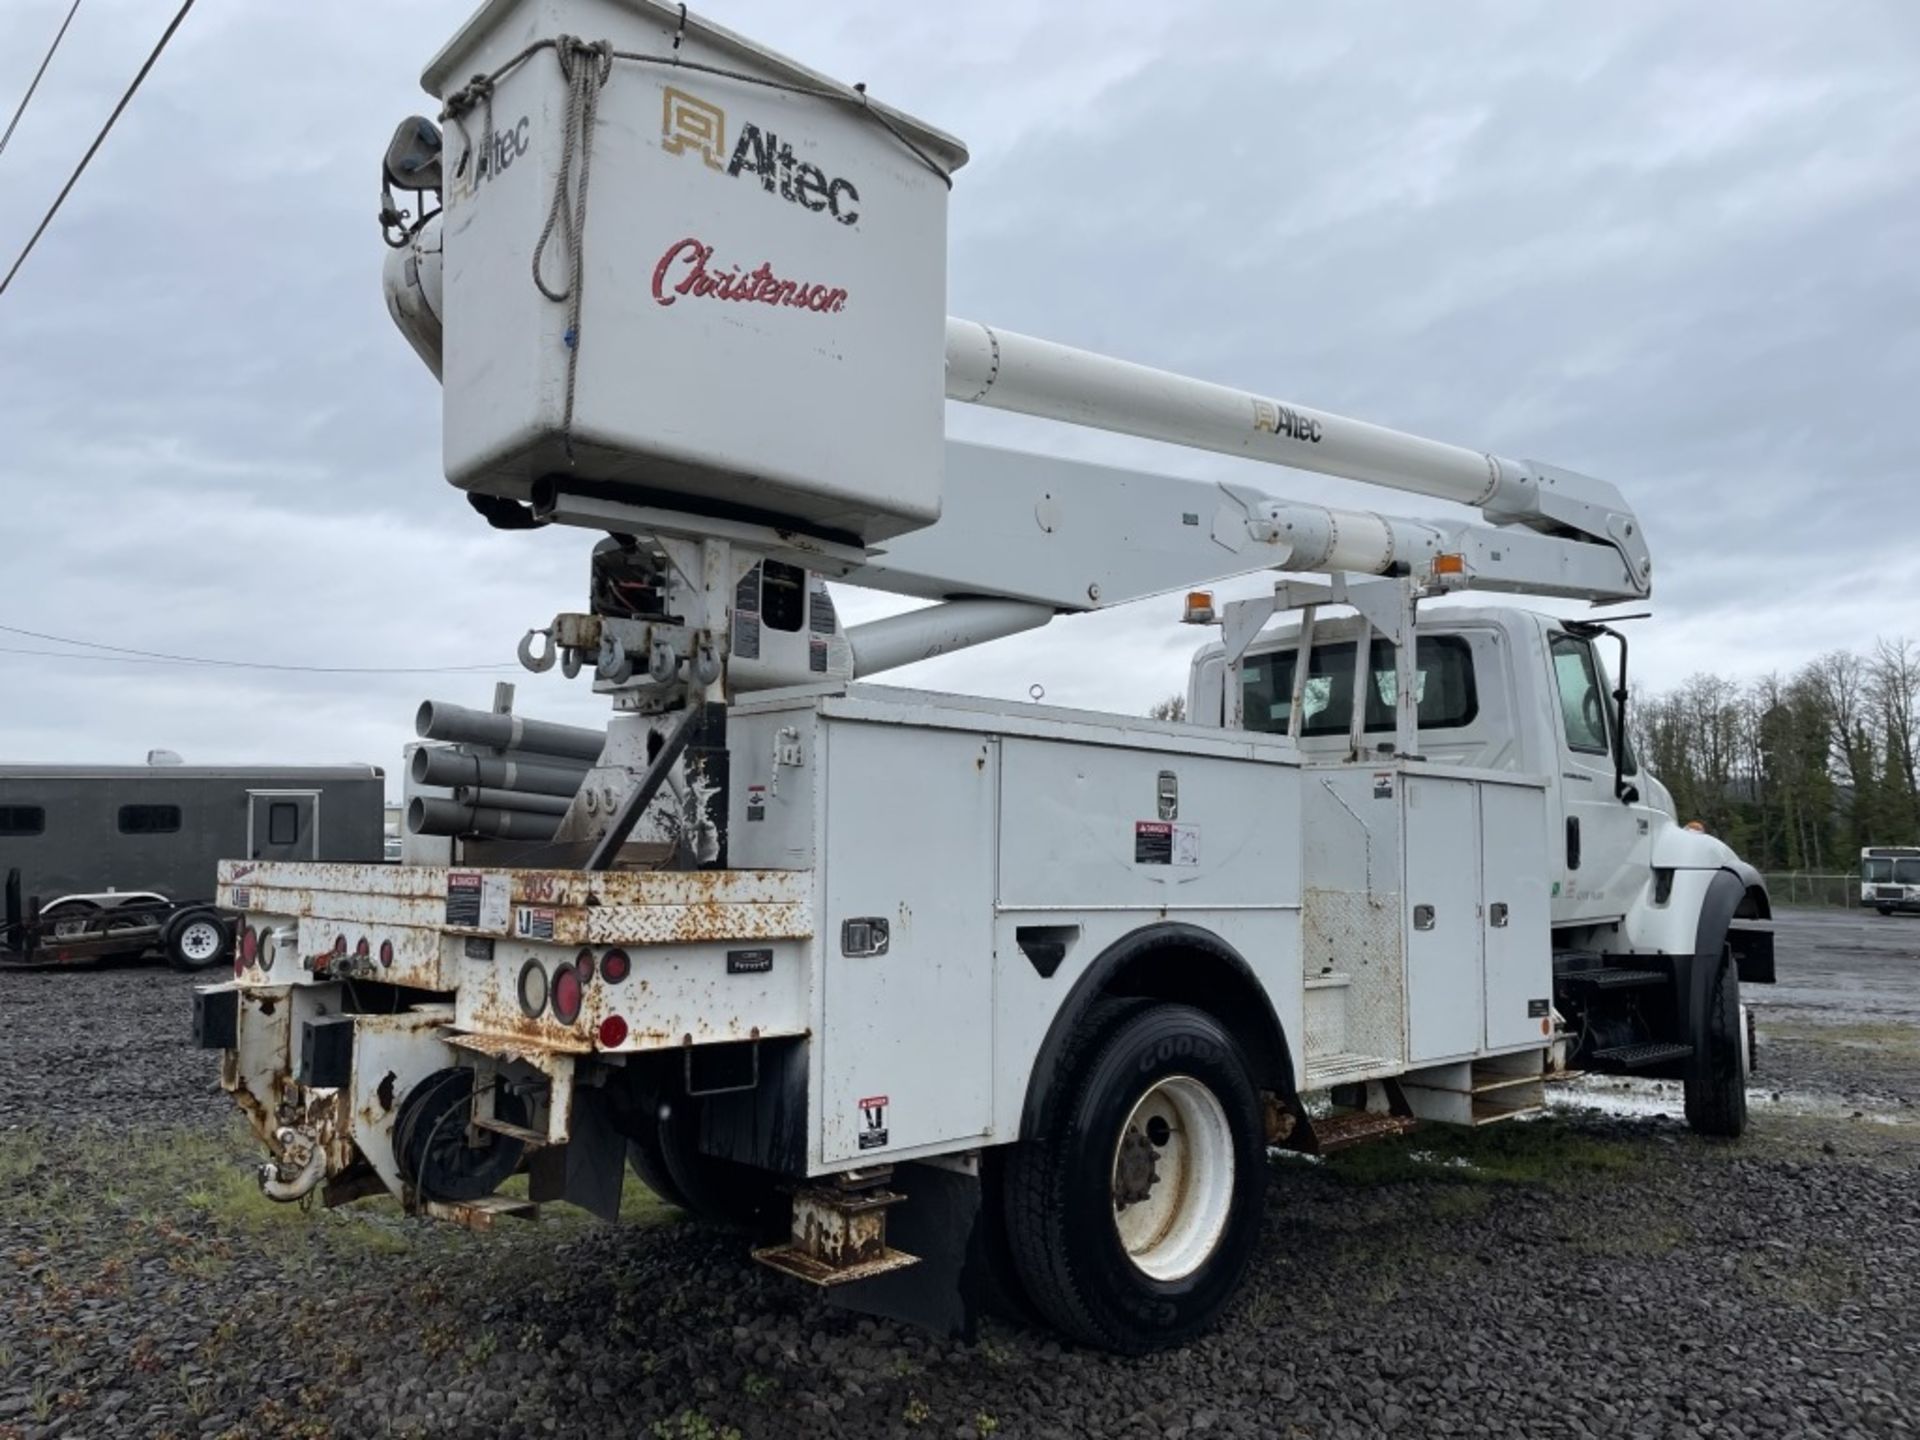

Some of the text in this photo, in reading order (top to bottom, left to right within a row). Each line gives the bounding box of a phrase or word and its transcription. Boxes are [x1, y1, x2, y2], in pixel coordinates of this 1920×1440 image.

[726, 121, 860, 226] Altec
[652, 238, 848, 313] Christenson
[1275, 404, 1322, 443] Altec
